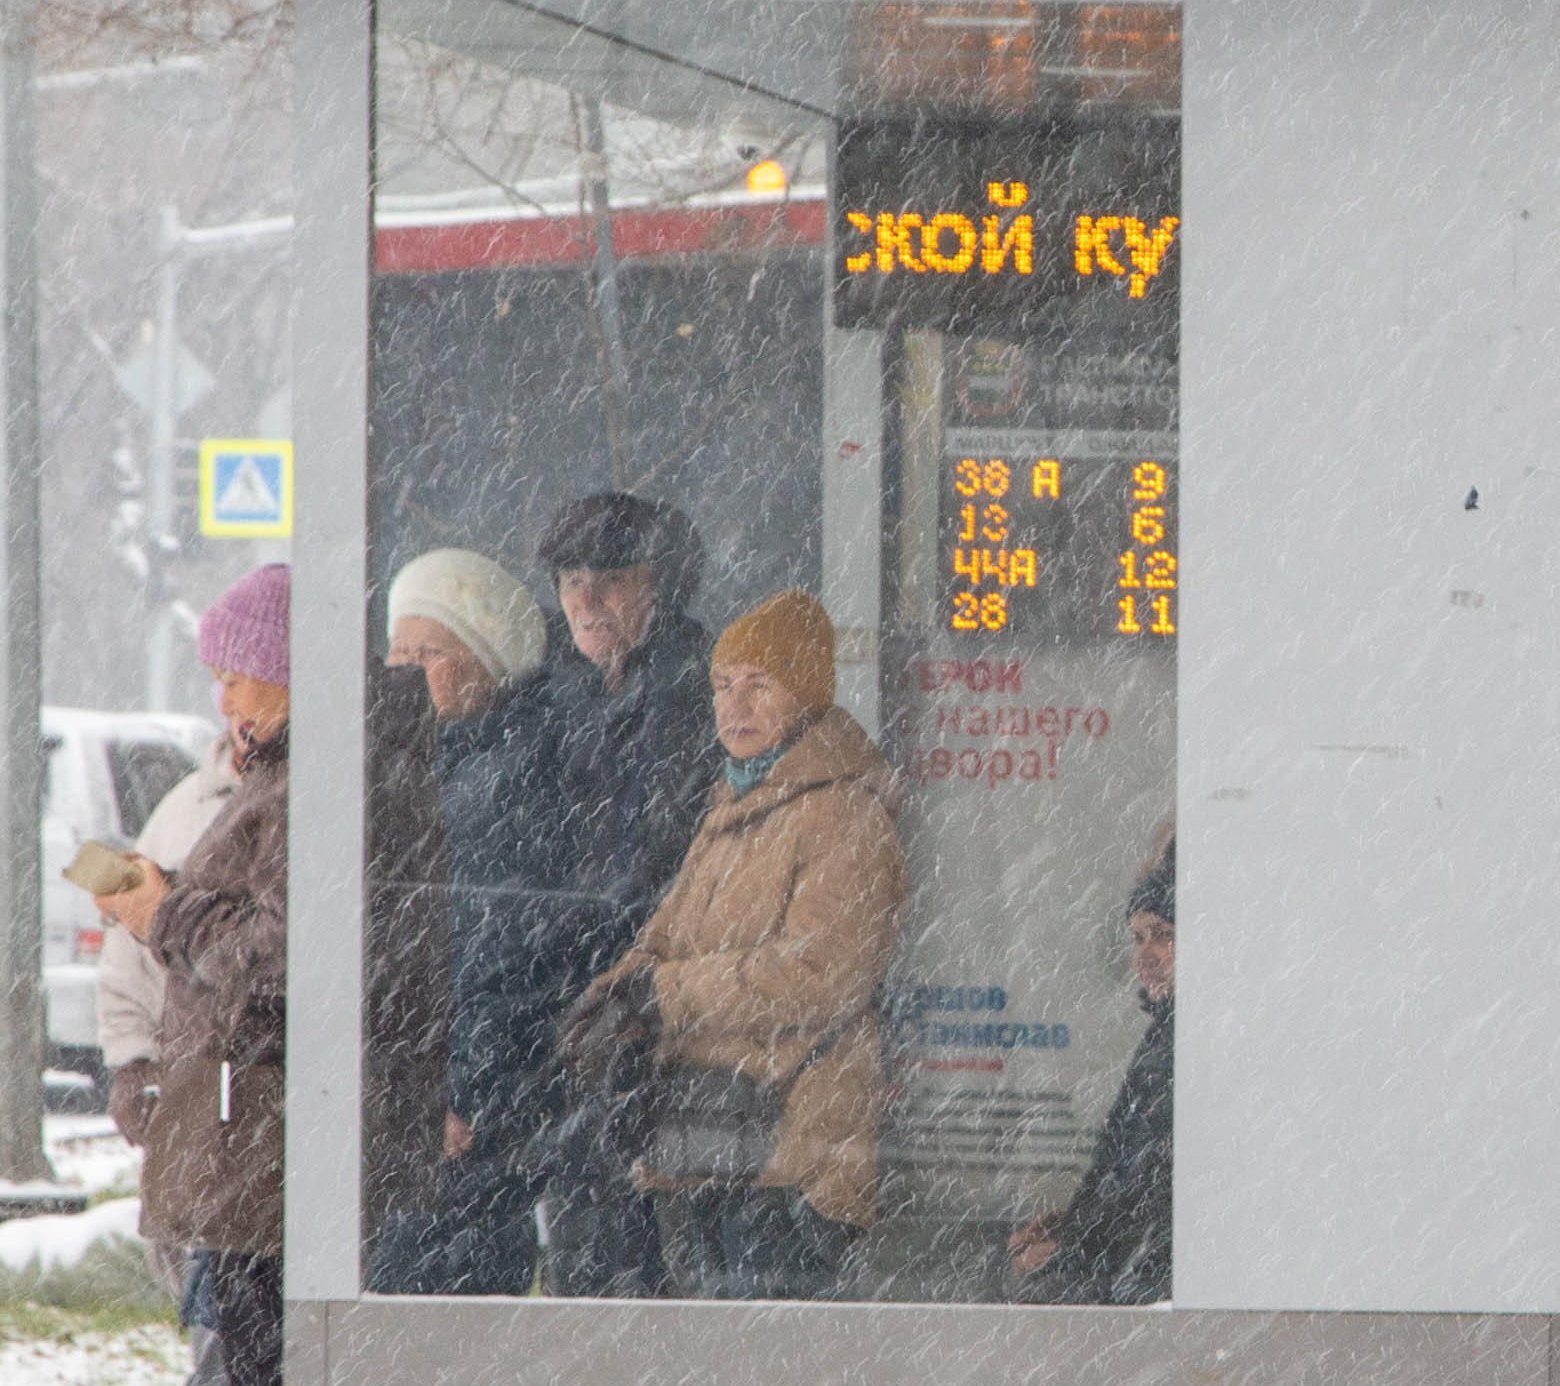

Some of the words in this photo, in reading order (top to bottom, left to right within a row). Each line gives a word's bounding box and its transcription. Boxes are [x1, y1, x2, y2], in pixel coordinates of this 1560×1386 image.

[1074, 215, 1180, 299] ку
[954, 458, 1011, 498] 38
[1032, 459, 1061, 499] А
[1131, 460, 1167, 501] 9
[958, 503, 1009, 542] 13
[1131, 505, 1166, 545] 6
[953, 547, 1037, 587] 44А
[1117, 549, 1178, 589] 12
[951, 591, 1007, 631] 28
[1117, 593, 1177, 635] 11
[935, 702, 1114, 739] нашего
